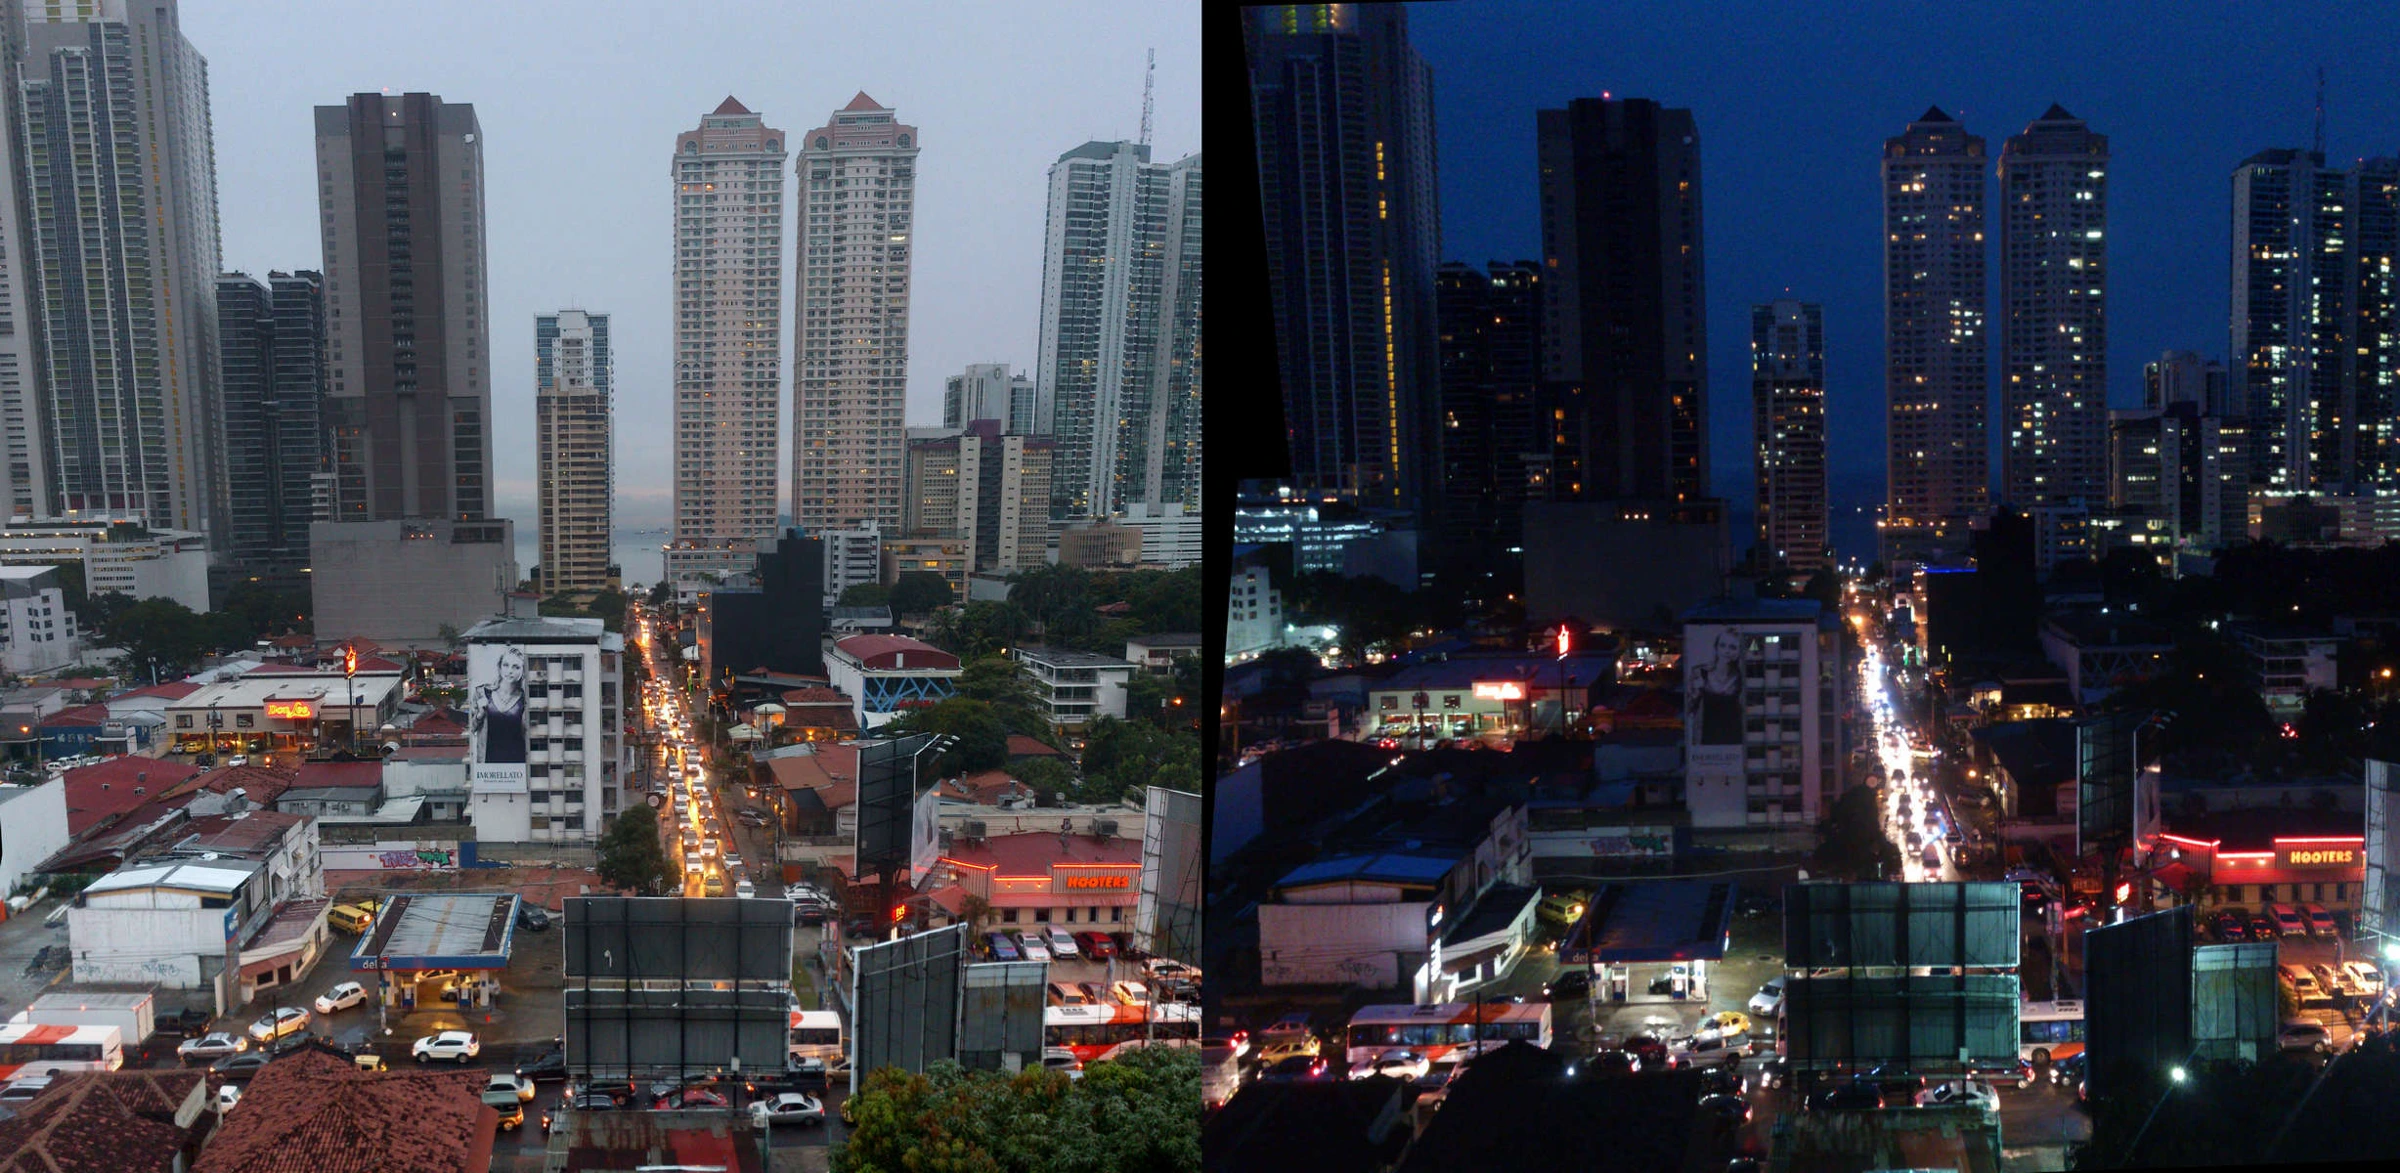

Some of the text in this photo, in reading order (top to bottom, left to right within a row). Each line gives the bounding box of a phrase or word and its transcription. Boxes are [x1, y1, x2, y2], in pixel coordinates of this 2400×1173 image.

[2290, 850, 2353, 864] HOOTERS
[1067, 875, 1130, 889] HOOTERS
[1572, 952, 1599, 963] dela
[363, 959, 388, 970] dela
